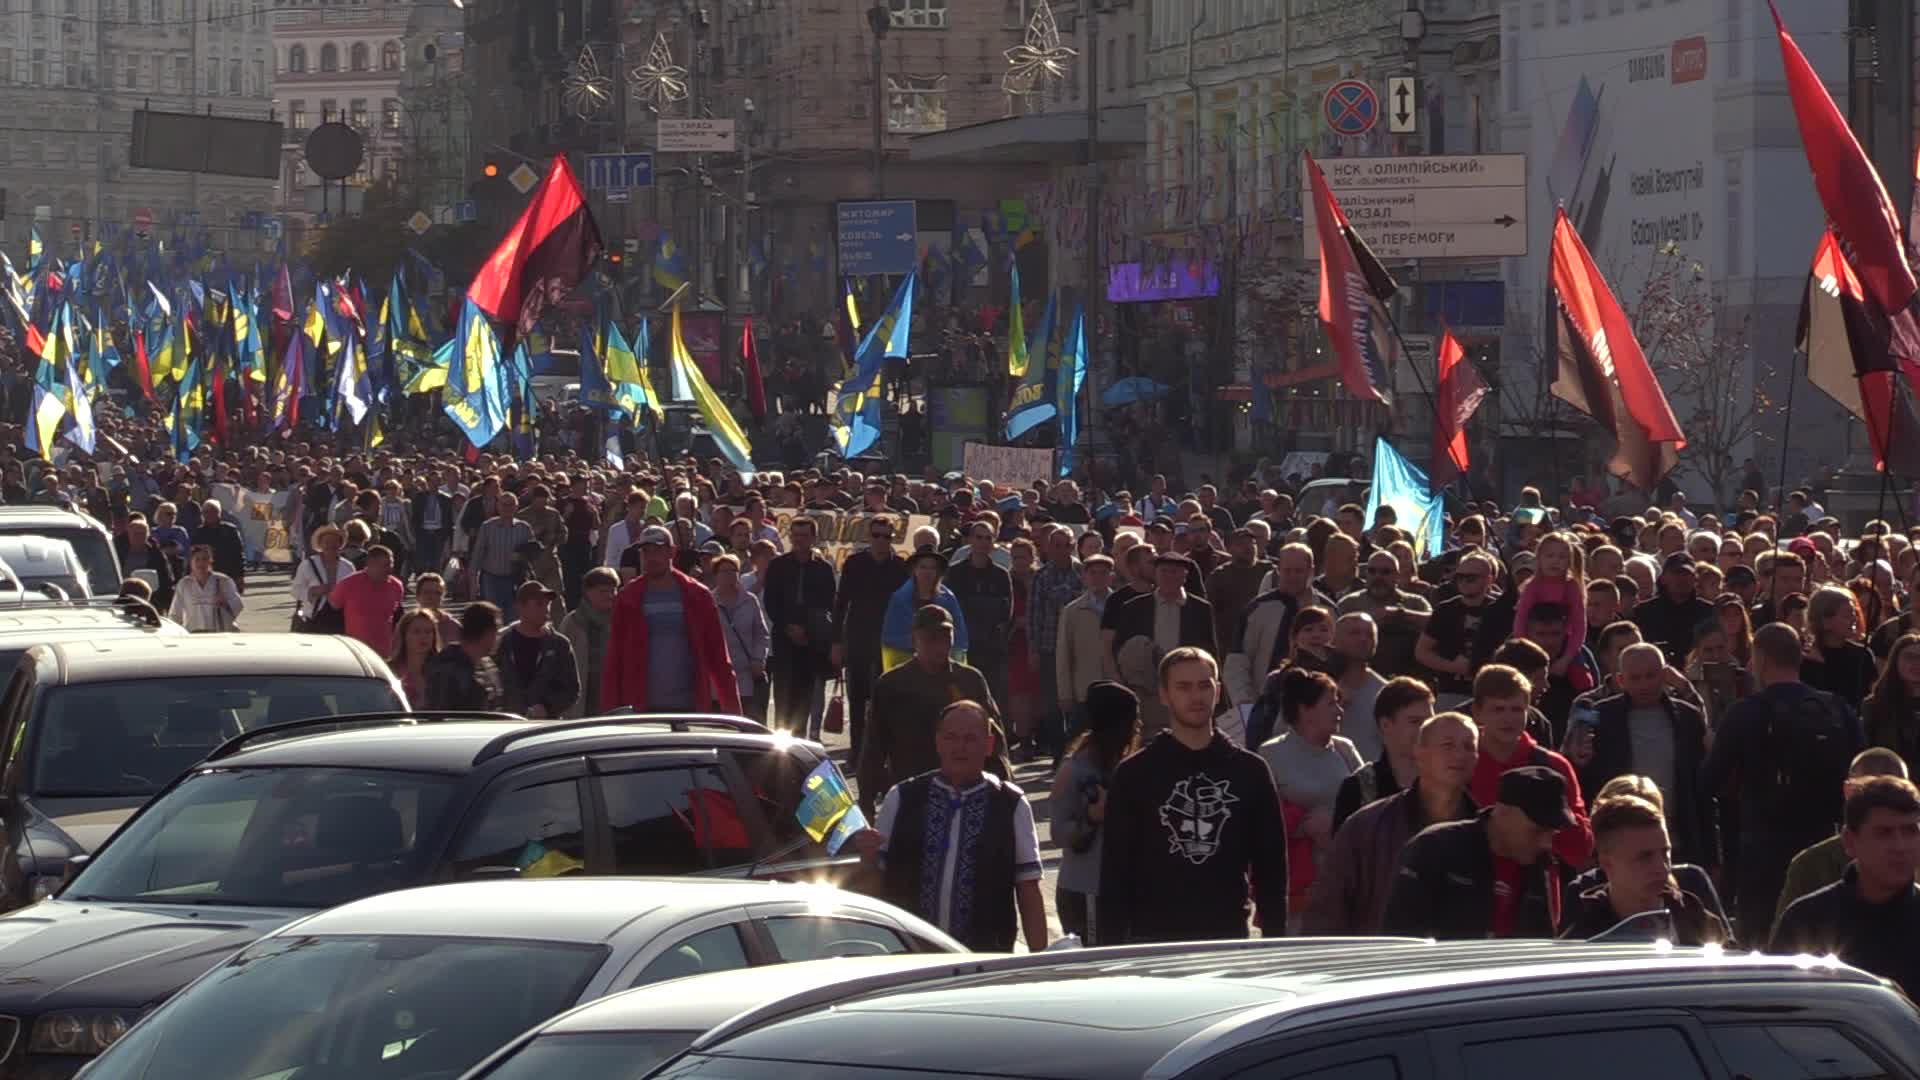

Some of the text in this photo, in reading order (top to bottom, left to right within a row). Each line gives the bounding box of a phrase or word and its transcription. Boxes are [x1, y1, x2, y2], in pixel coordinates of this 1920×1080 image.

[1628, 54, 1665, 84] SAMSUNG
[1334, 164, 1361, 176] НСК
[1345, 207, 1392, 220] ОКЗАЛ
[1382, 232, 1456, 245] ПЕРЕМОГИ
